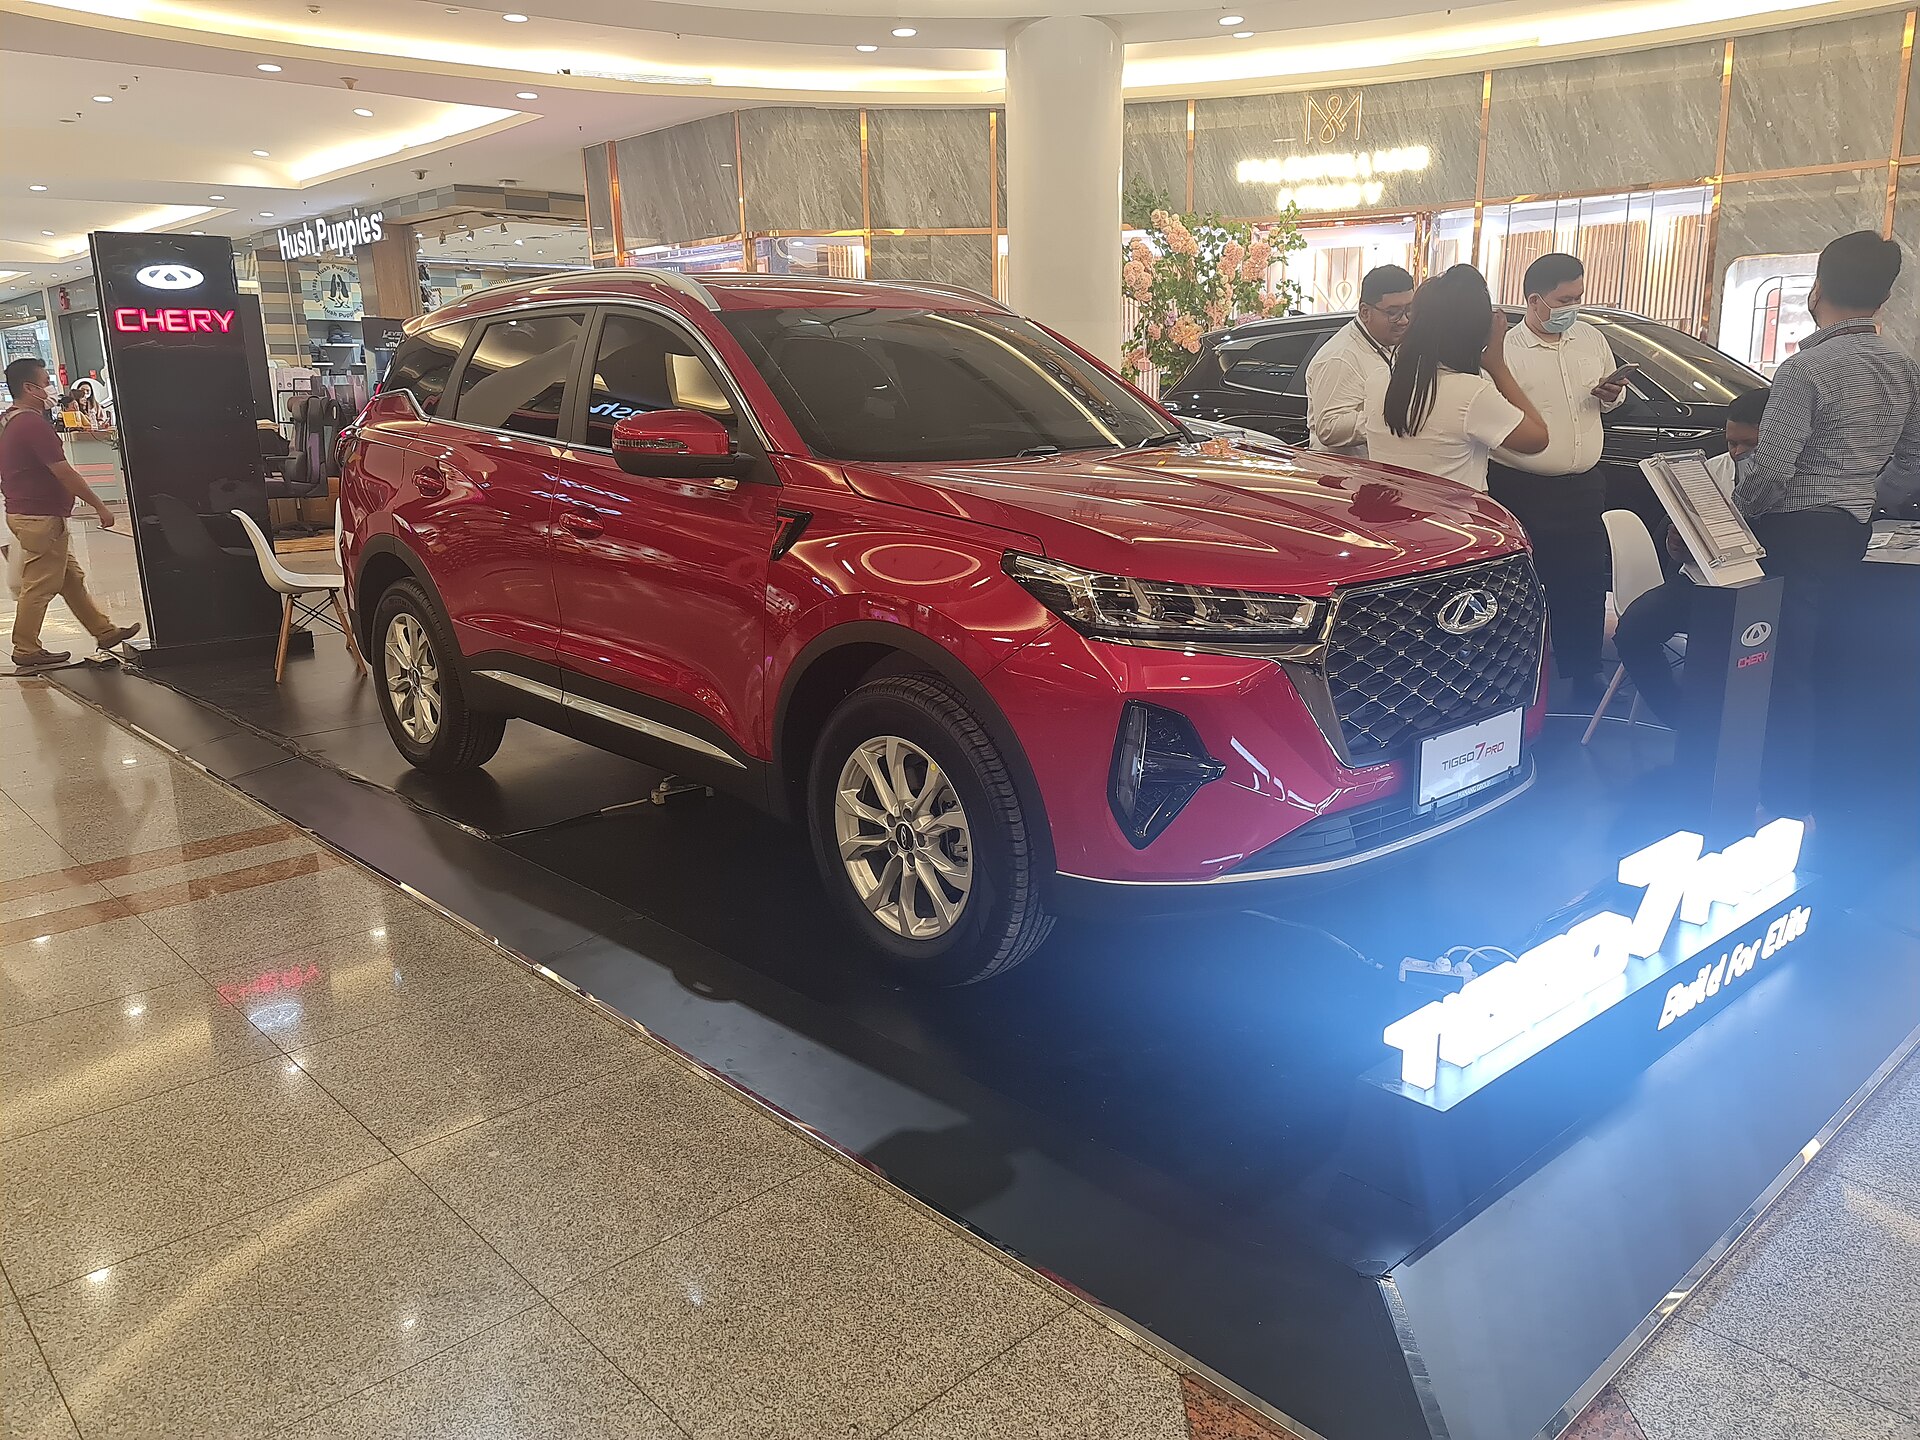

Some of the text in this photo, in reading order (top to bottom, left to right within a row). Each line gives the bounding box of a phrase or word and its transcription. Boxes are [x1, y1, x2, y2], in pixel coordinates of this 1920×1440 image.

[277, 208, 383, 260] Hush Puppies
[115, 308, 235, 333] CHERY
[1737, 651, 1769, 668] CHERY
[1441, 751, 1475, 770] TIGGO
[1484, 741, 1505, 757] PRO
[1657, 953, 1728, 1031] Build
